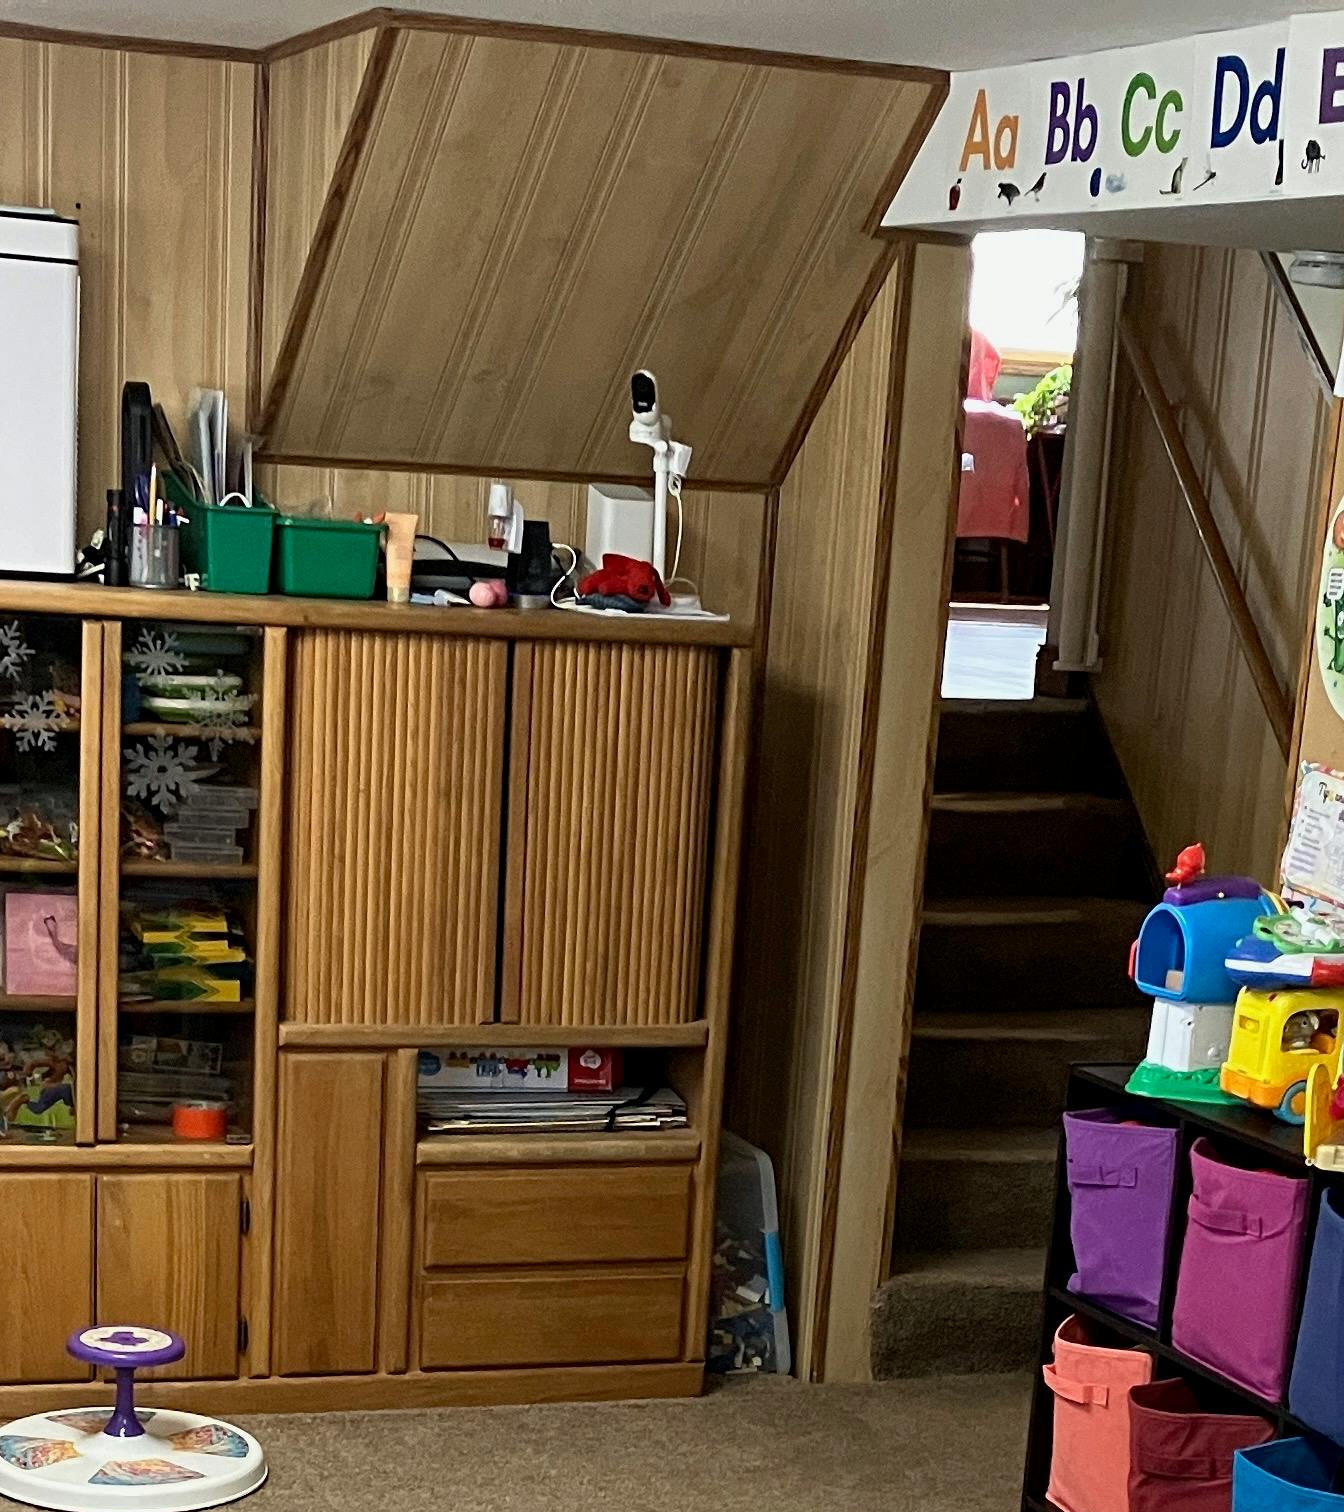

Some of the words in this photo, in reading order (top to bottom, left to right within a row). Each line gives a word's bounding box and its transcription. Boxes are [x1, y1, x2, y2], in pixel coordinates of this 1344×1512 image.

[960, 89, 1018, 172] Aa
[1044, 78, 1099, 166] Bb
[1121, 72, 1184, 157] Cc
[1210, 47, 1284, 150] Dd
